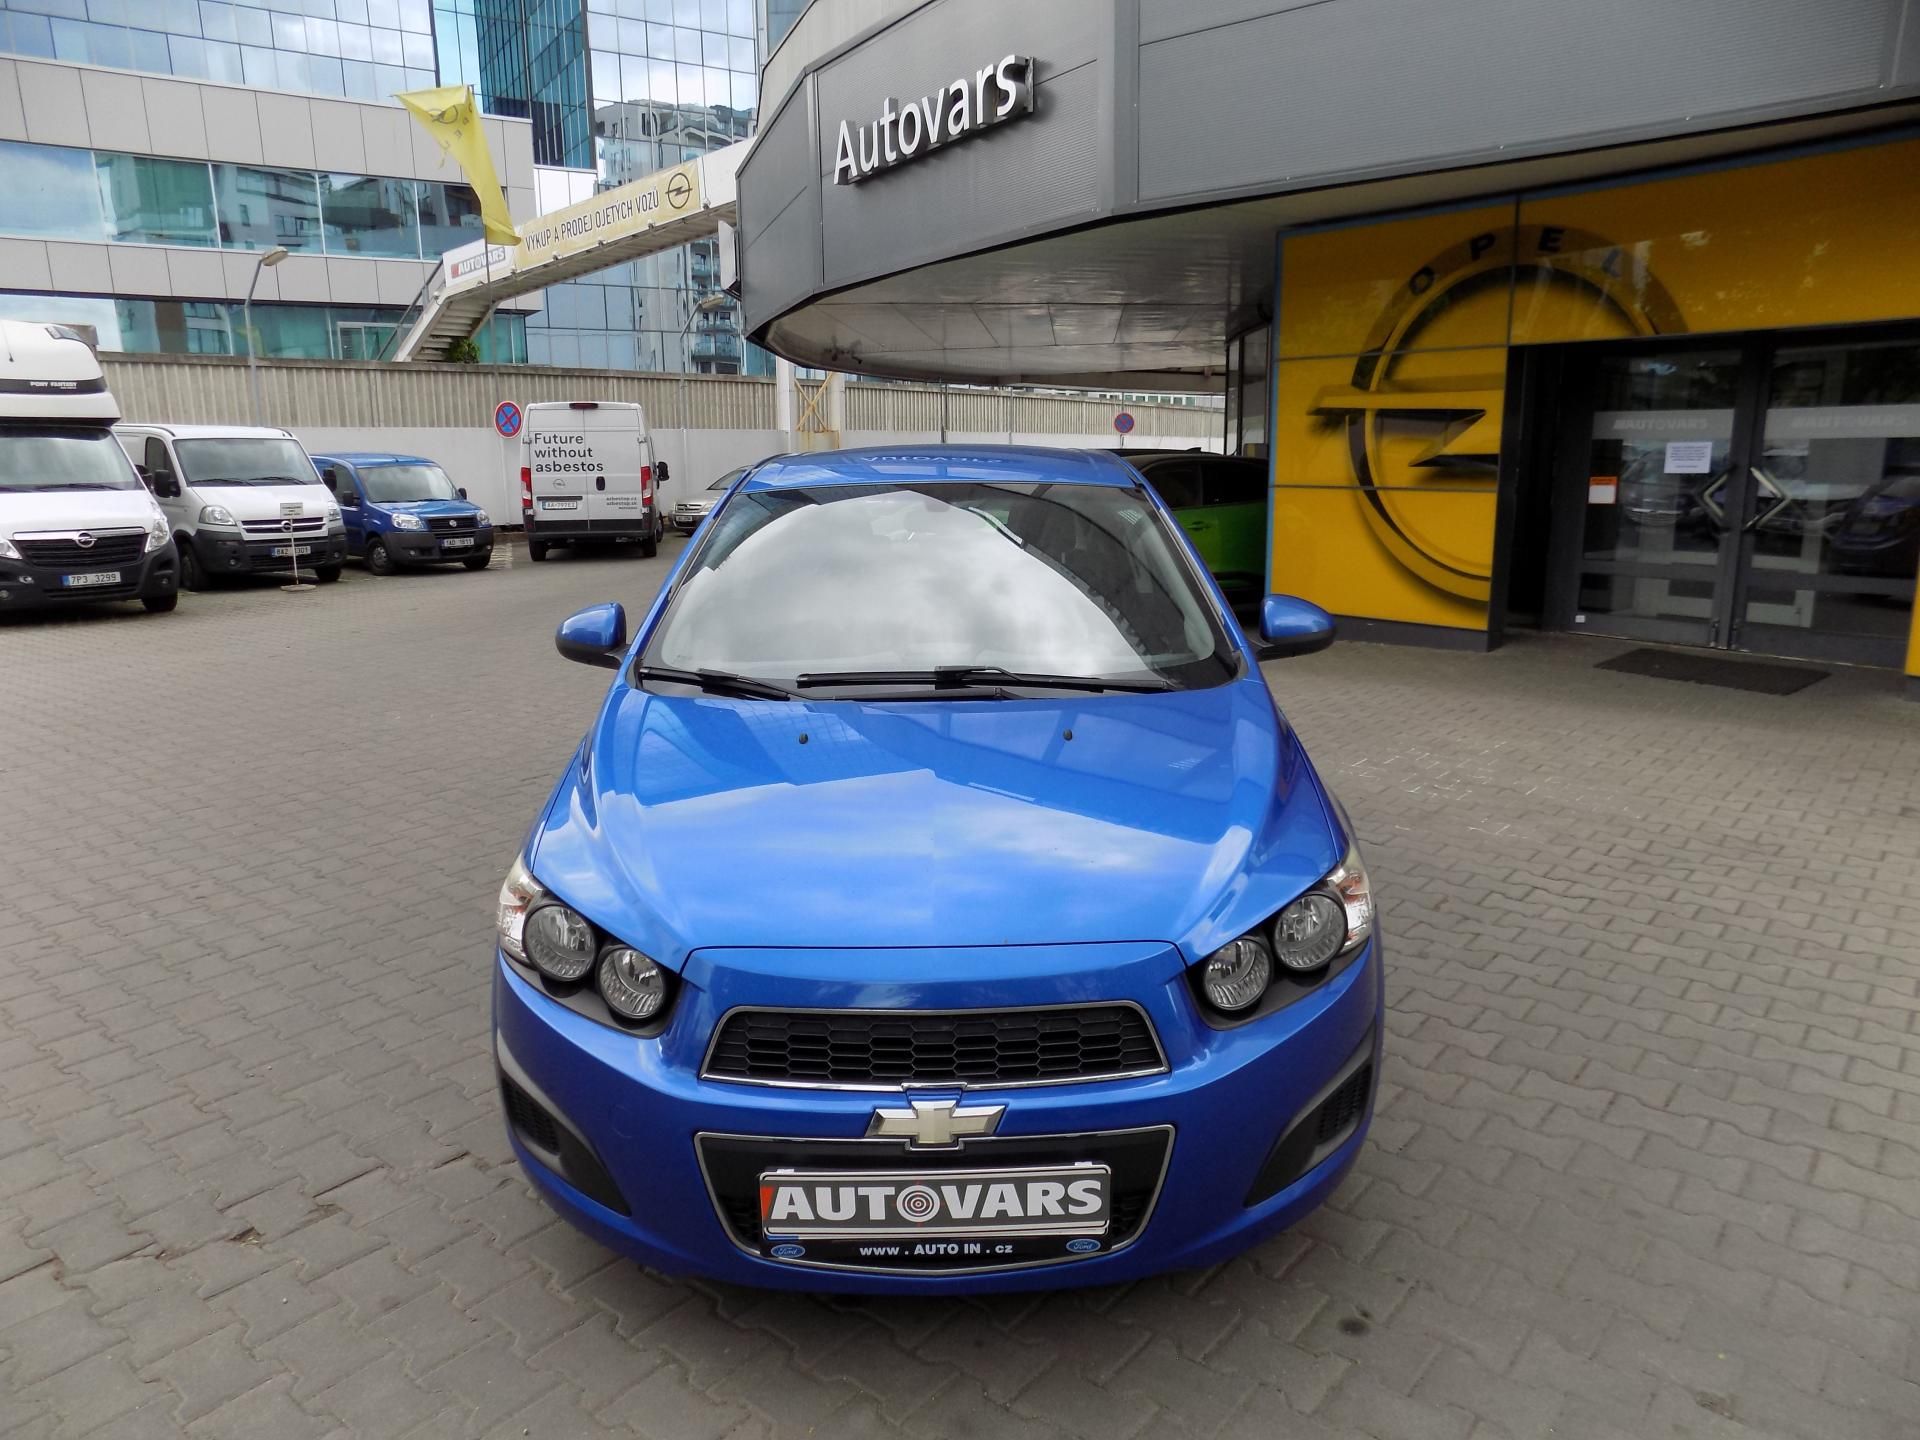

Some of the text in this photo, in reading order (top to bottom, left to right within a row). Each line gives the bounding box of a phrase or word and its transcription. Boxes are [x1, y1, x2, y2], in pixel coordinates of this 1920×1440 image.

[834, 54, 1017, 185] Autovars
[525, 187, 659, 252] VÝKUP A PRODEJ OJETÝCH VOZŮ
[459, 248, 505, 275] AUTOVARS
[1408, 226, 1623, 297] OPEL
[534, 433, 584, 444] Future
[534, 446, 593, 458] without
[535, 460, 604, 473] asbestos
[71, 573, 117, 585] 7P3 3299
[771, 1180, 1103, 1223] AUTOVARS
